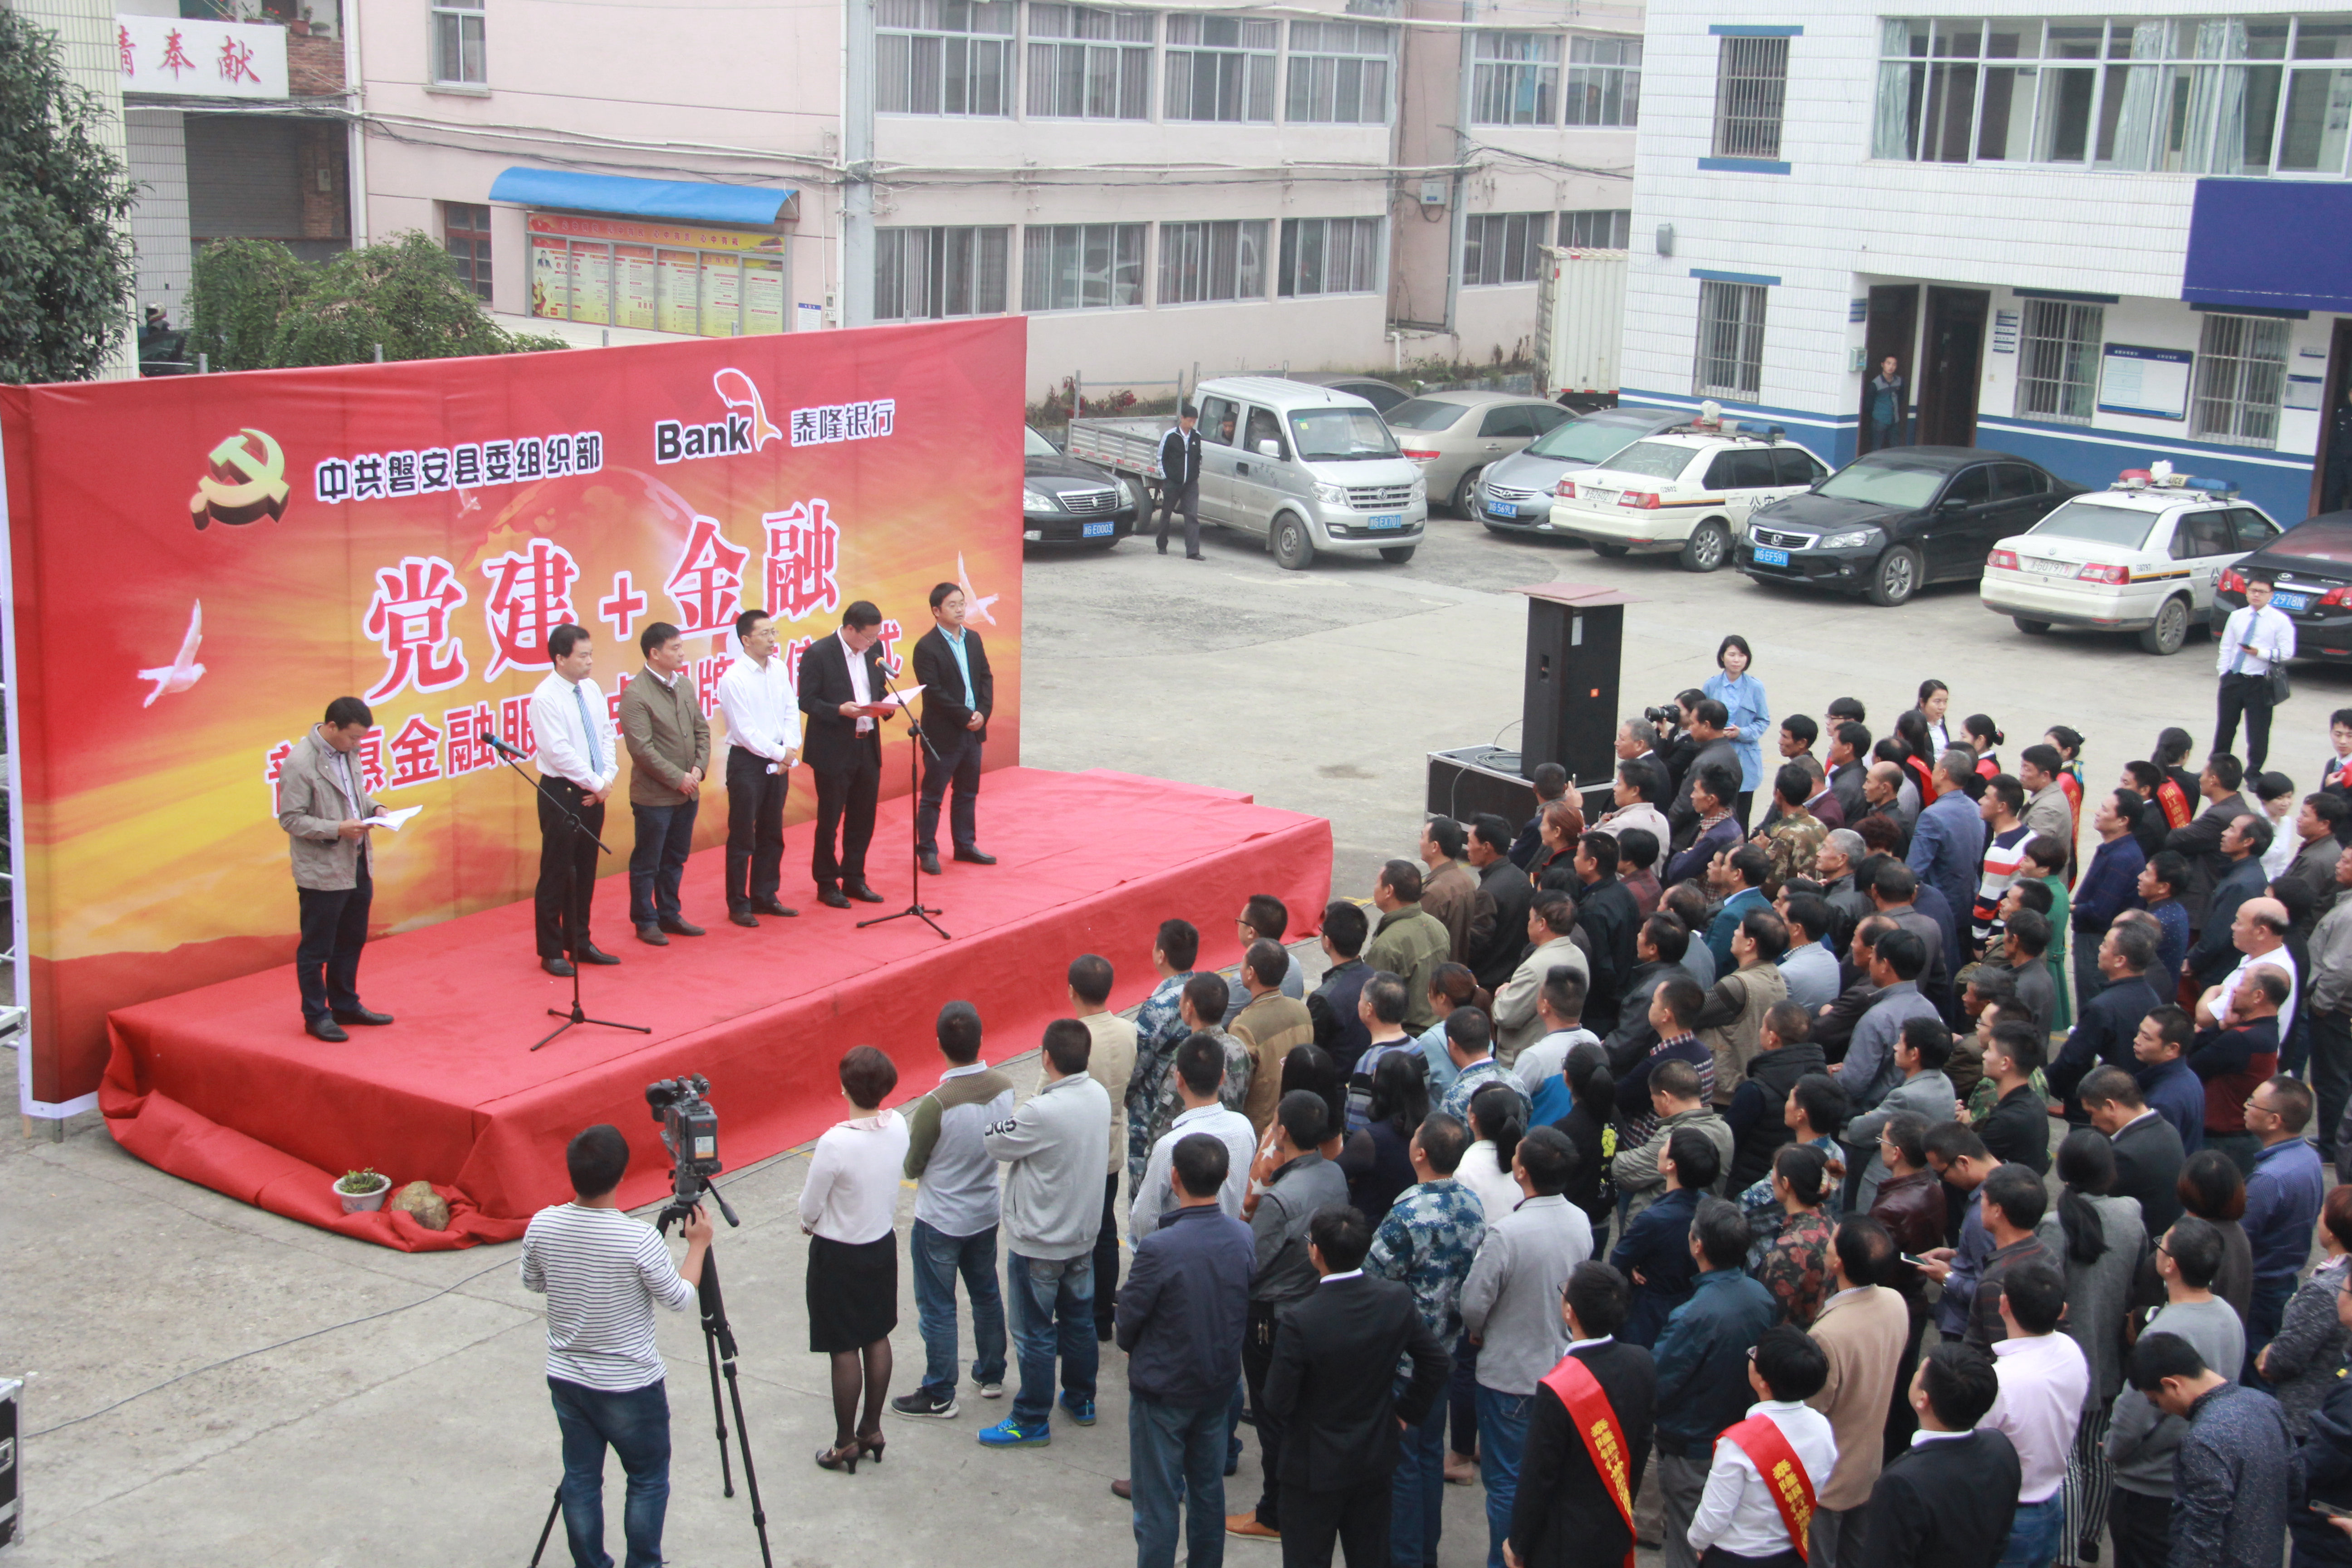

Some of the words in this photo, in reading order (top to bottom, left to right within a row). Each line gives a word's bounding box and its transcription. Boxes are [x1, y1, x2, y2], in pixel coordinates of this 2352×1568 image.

[608, 225, 644, 237] 心中有民
[658, 415, 750, 461] Bank
[792, 401, 894, 445] 泰隆银行
[319, 434, 600, 499] 中共磐安县委组织部
[2167, 477, 2184, 485] LICE
[2136, 564, 2151, 572] G0797
